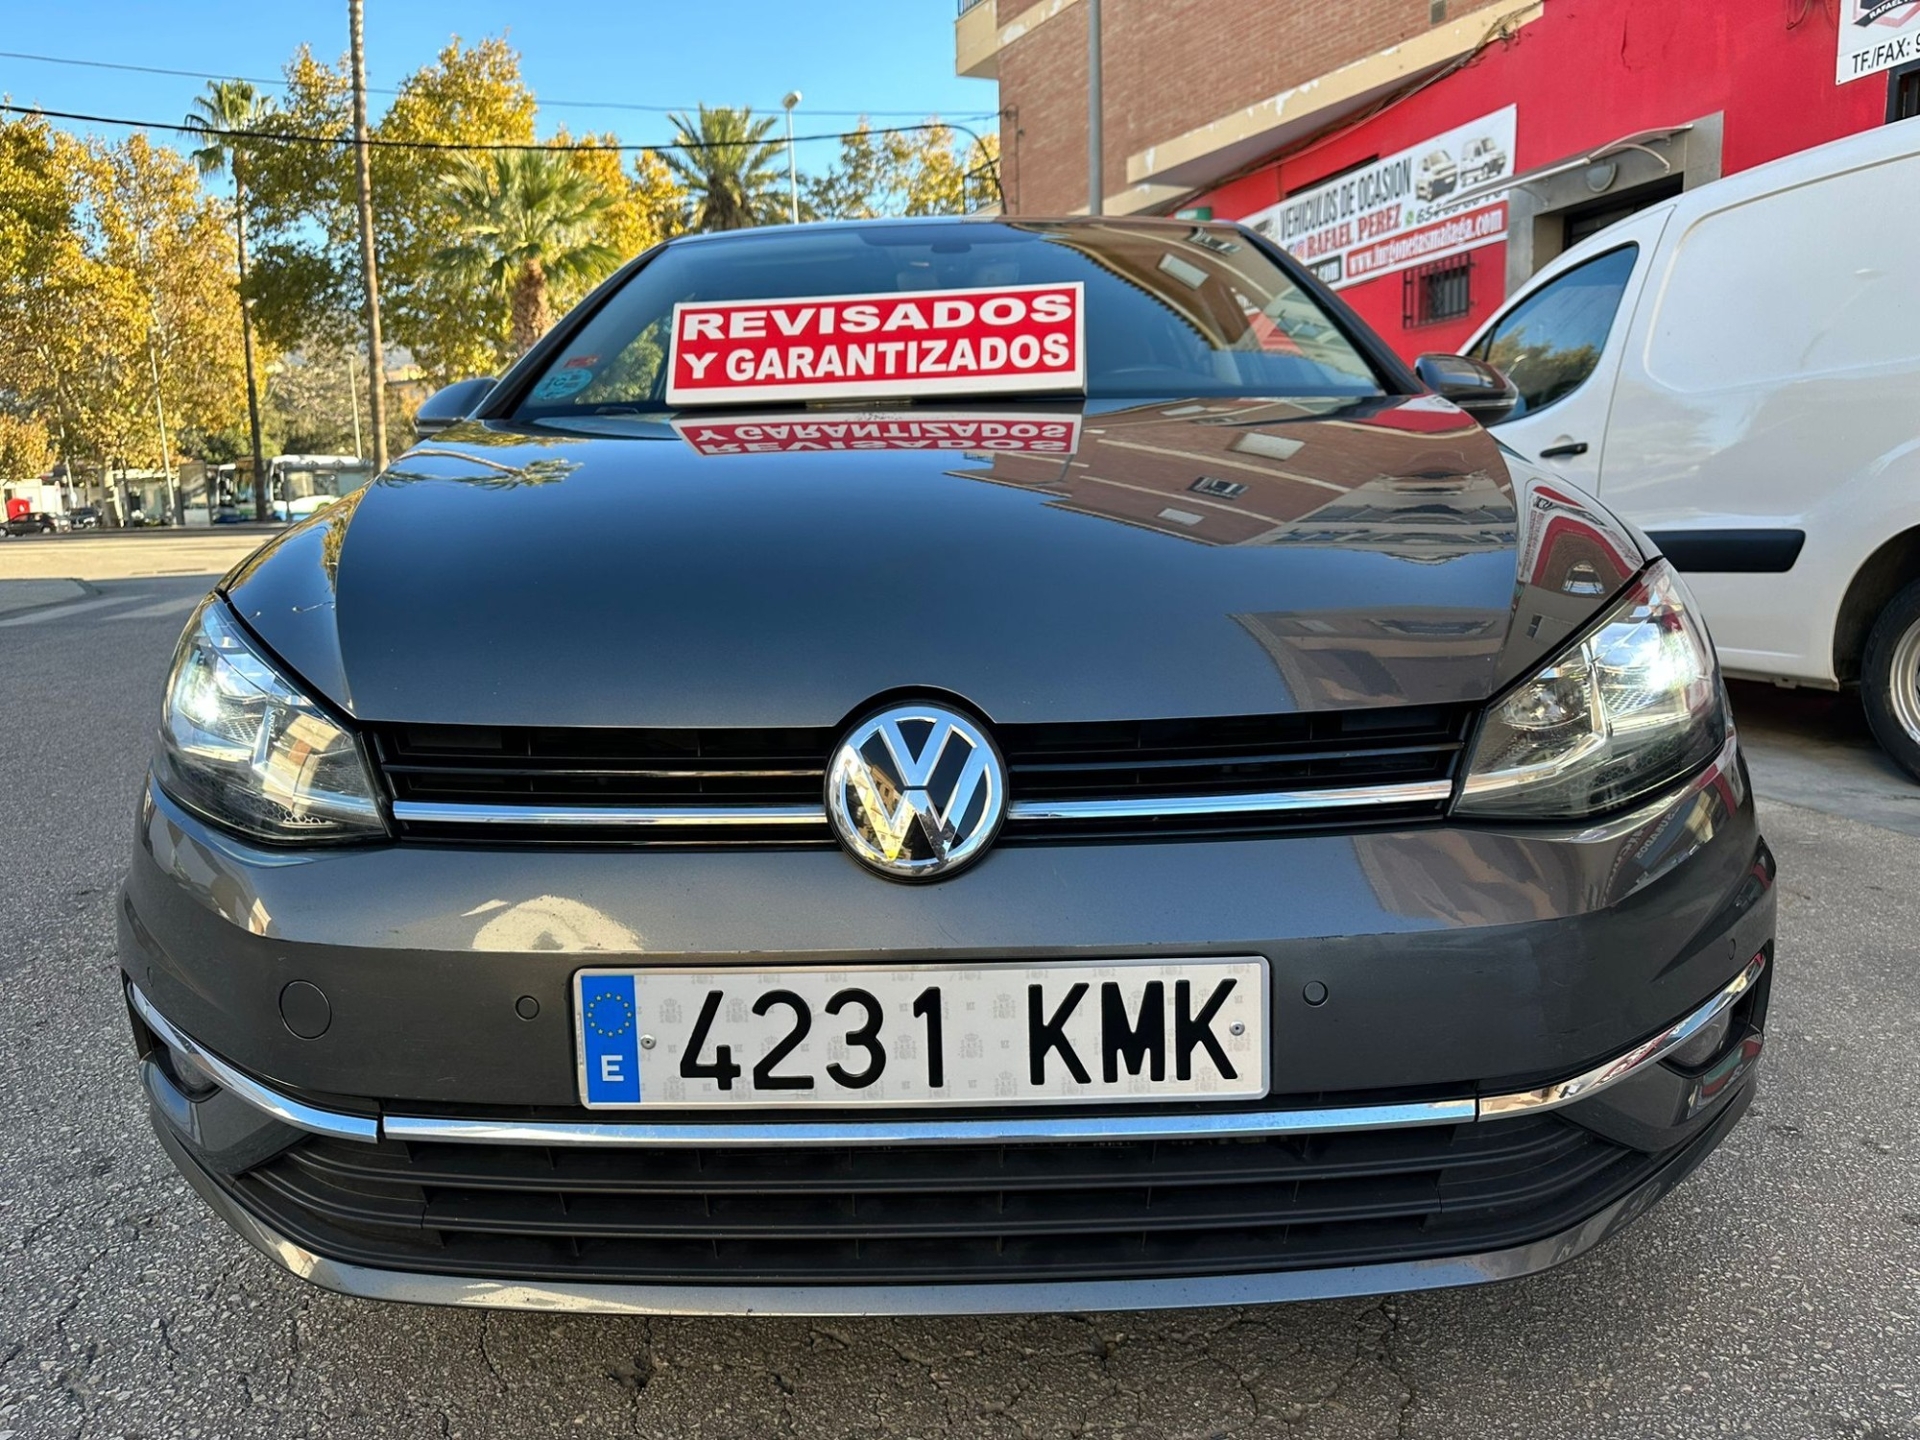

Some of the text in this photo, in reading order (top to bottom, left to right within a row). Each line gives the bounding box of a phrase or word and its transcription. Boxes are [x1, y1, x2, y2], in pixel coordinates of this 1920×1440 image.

[1852, 37, 1910, 74] TF./FAX:
[1280, 189, 1338, 241] VEHICULOS
[1340, 182, 1355, 218] DE
[1307, 203, 1401, 259] RAFAEL PEREZ
[682, 295, 1072, 342] REVISADOS
[682, 333, 1069, 382] Y GARANTIZADOS
[680, 986, 943, 1091] 4231
[1027, 978, 1238, 1086] KMK
[600, 1055, 625, 1082] E
